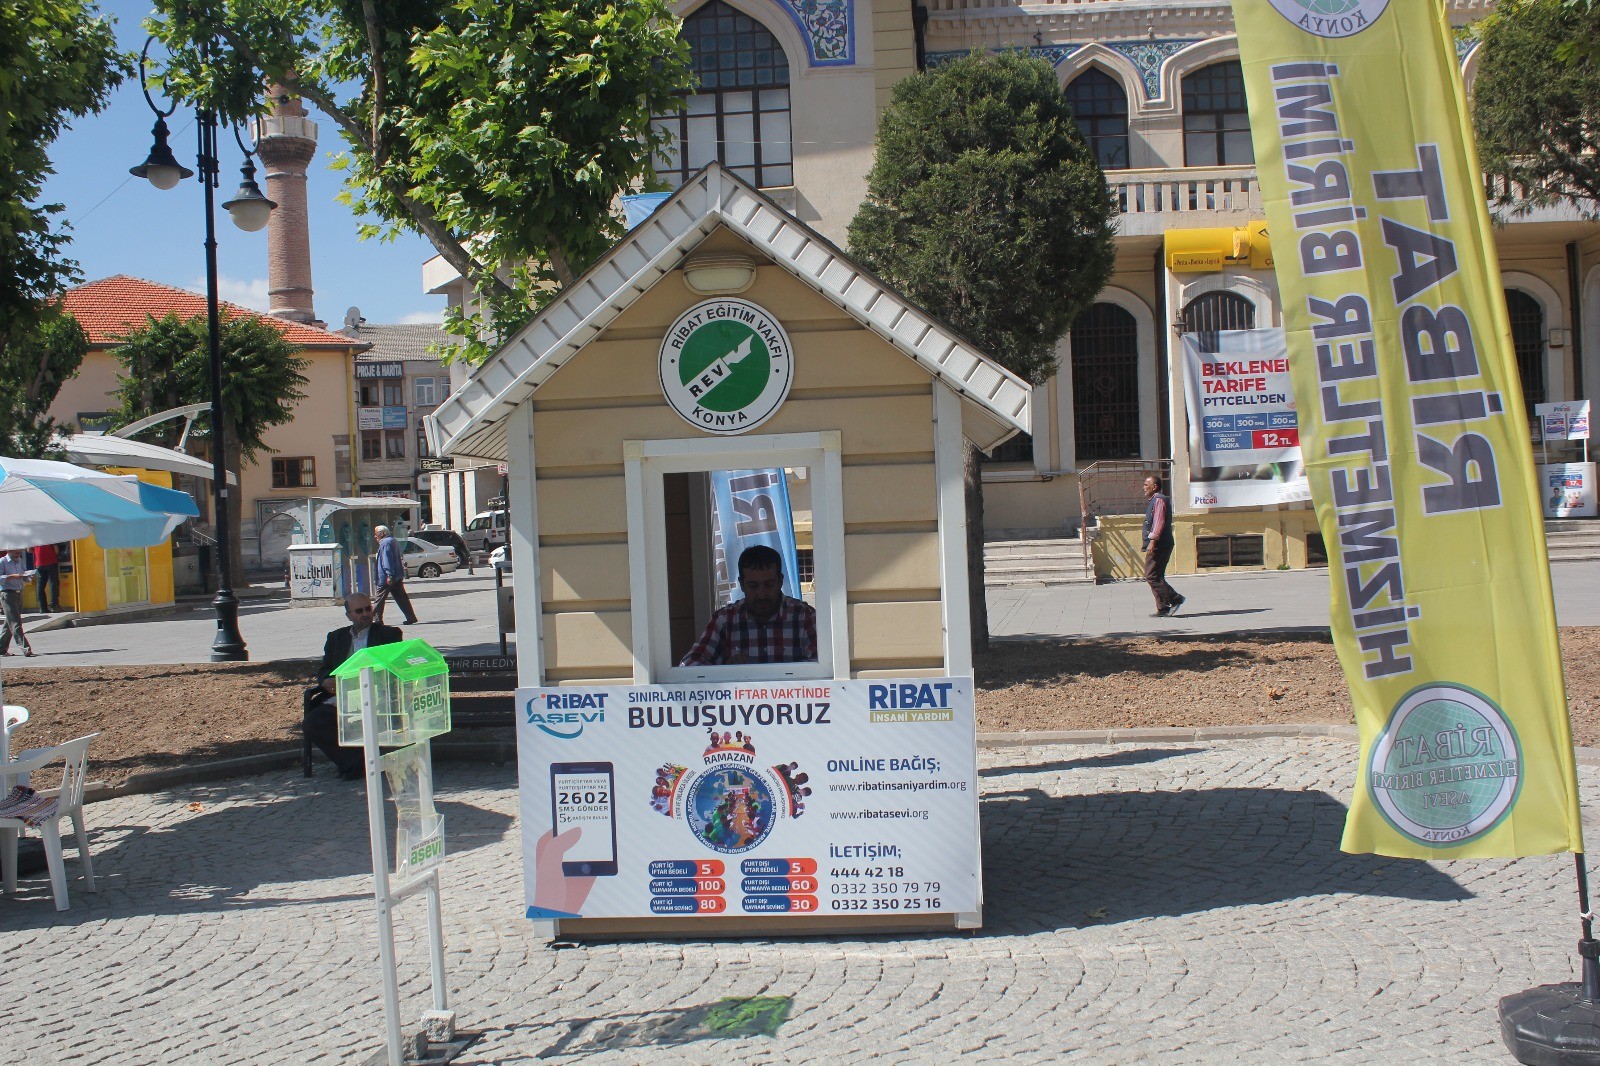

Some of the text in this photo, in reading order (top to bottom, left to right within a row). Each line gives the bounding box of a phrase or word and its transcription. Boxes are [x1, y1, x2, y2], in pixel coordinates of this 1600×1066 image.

[671, 304, 783, 359] RİBAT EĞİTİM VAKFI
[357, 362, 402, 377] PROJE & HARİTA
[689, 364, 724, 398] REV
[1204, 394, 1286, 407] PTTCELL'DEN
[692, 406, 748, 425] KONYA
[1272, 417, 1288, 425] 300
[1262, 433, 1292, 446] 12 TL
[472, 658, 516, 668] BELEDİY
[628, 685, 831, 704] SINIRLARI AŞIYOR İFTAR VAKTİNDE
[628, 703, 831, 733] BULUŞUYORUZ
[873, 711, 949, 722] İNSANİ YARDIM
[703, 753, 754, 766] RAMAZAN
[827, 755, 941, 775] ONLİNE BAĞIŞ;
[829, 780, 967, 792] www.ribatinsaniyardim.org
[559, 791, 608, 805] 2602
[830, 809, 929, 820] www.ribatasevi.org
[829, 842, 901, 861] İLETİŞİM;
[830, 866, 904, 878] 444 42 18
[831, 882, 941, 895] 0332 350 79 79
[831, 898, 941, 910] 0332 350 25 16
